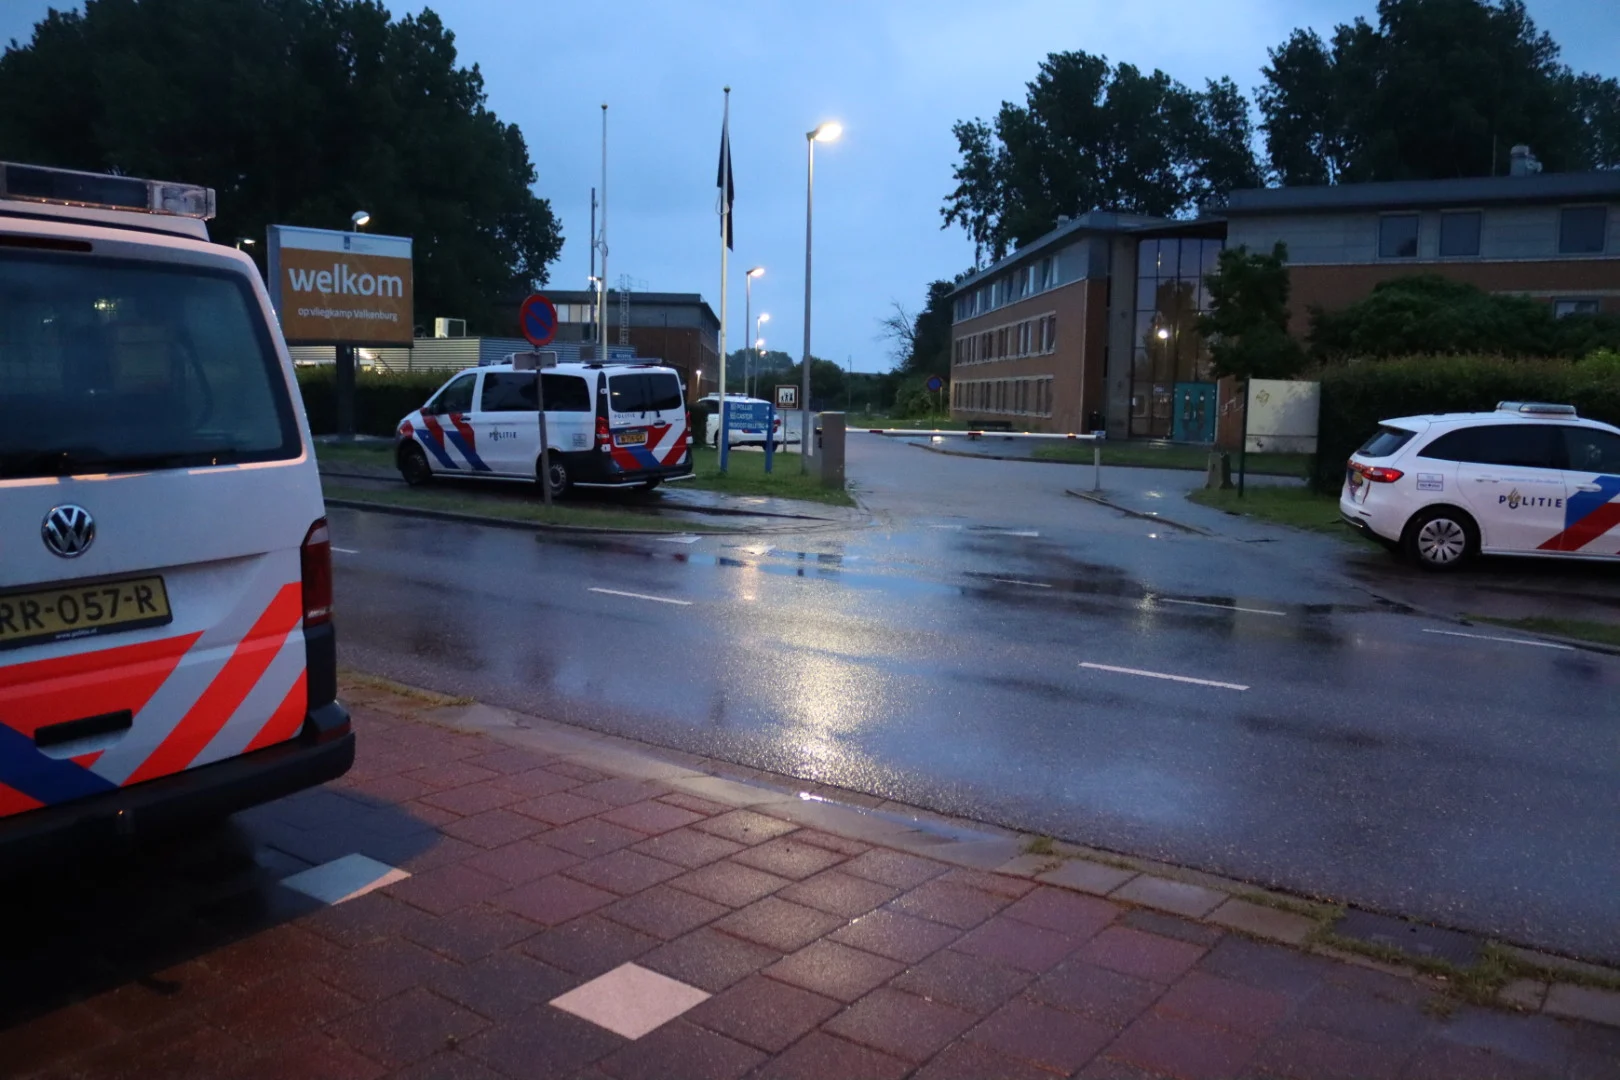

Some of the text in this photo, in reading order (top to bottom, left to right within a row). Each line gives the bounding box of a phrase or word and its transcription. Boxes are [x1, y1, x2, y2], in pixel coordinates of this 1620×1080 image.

[288, 264, 403, 298] welkom
[298, 307, 398, 323] op vliegkamp Valkenburg
[489, 430, 518, 442] POLITIE
[1498, 494, 1563, 510] POLITIE
[0, 584, 157, 634] RR-057-R
